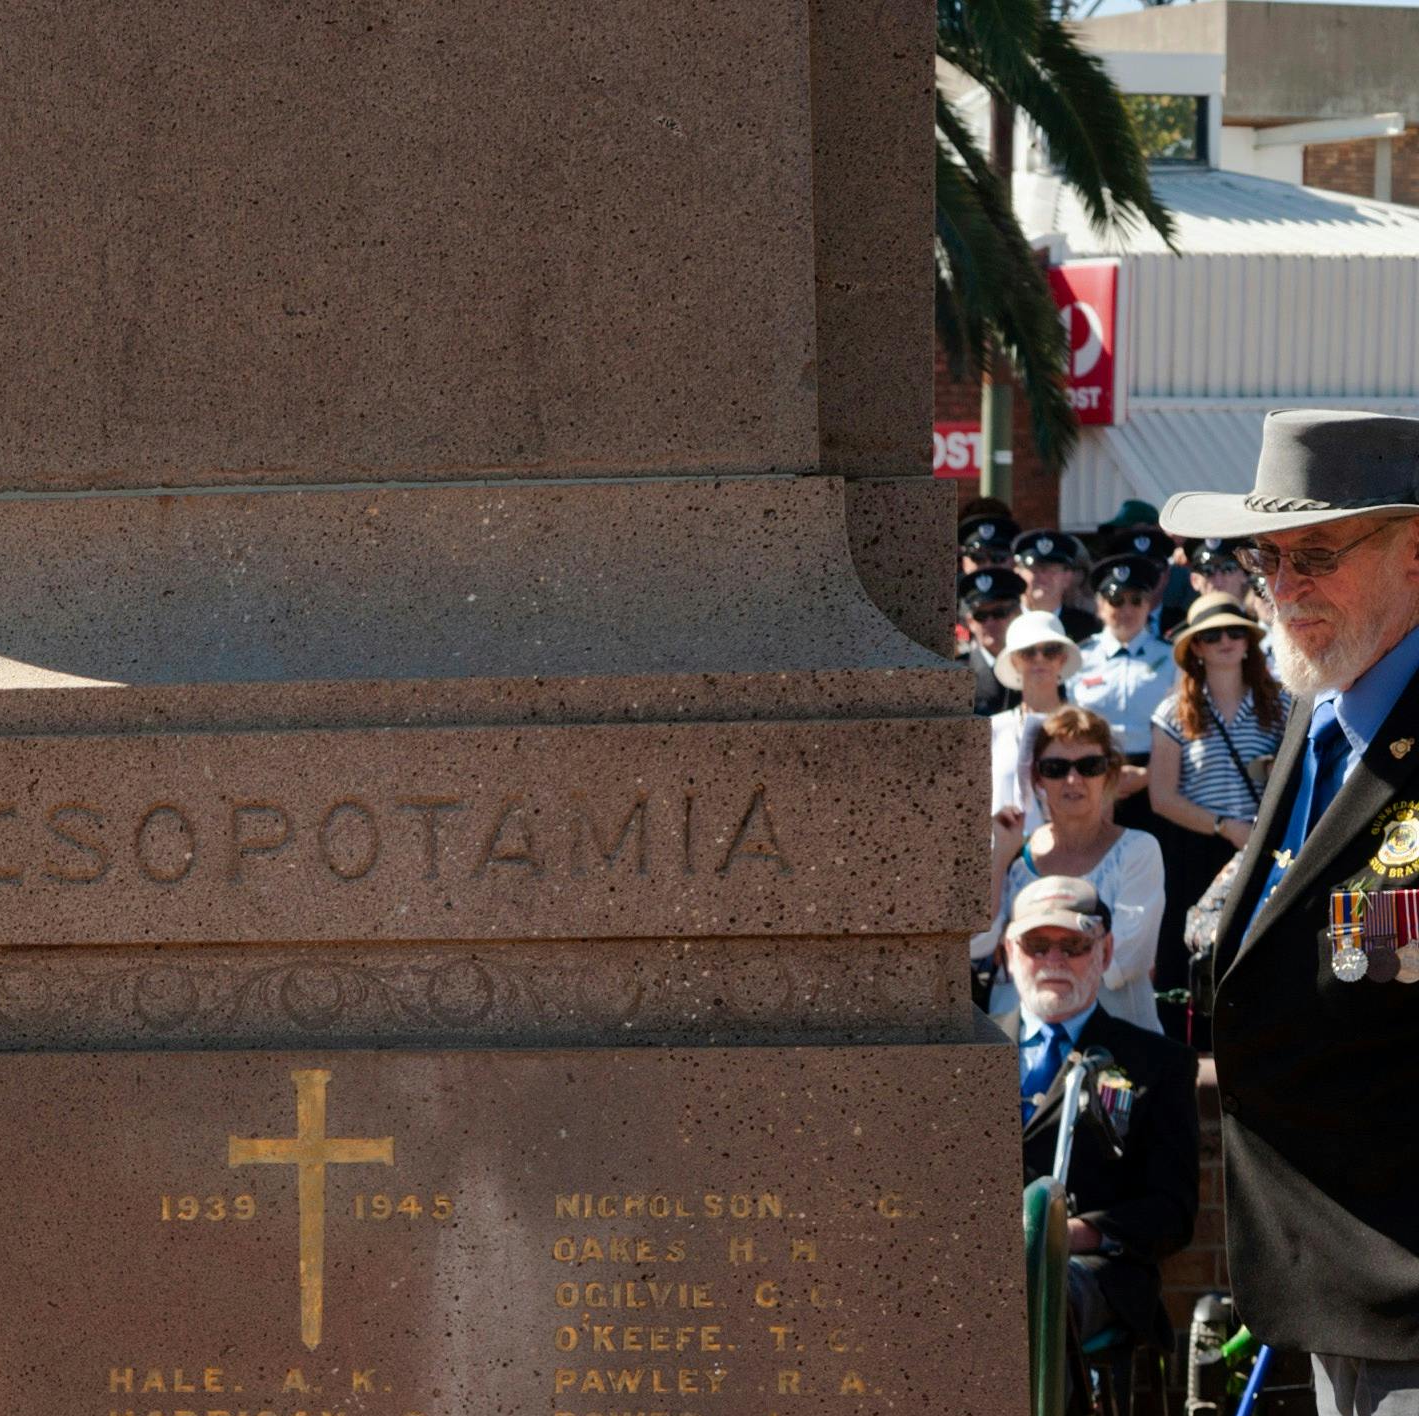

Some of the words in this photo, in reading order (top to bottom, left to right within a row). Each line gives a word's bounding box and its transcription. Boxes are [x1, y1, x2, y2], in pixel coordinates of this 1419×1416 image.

[1066, 386, 1102, 410] OST
[934, 430, 983, 470] OST
[1370, 800, 1419, 836] GUNNEDA
[161, 1194, 257, 1221] 1939
[354, 1194, 454, 1221] 1945
[109, 1367, 244, 1394] HALE.
